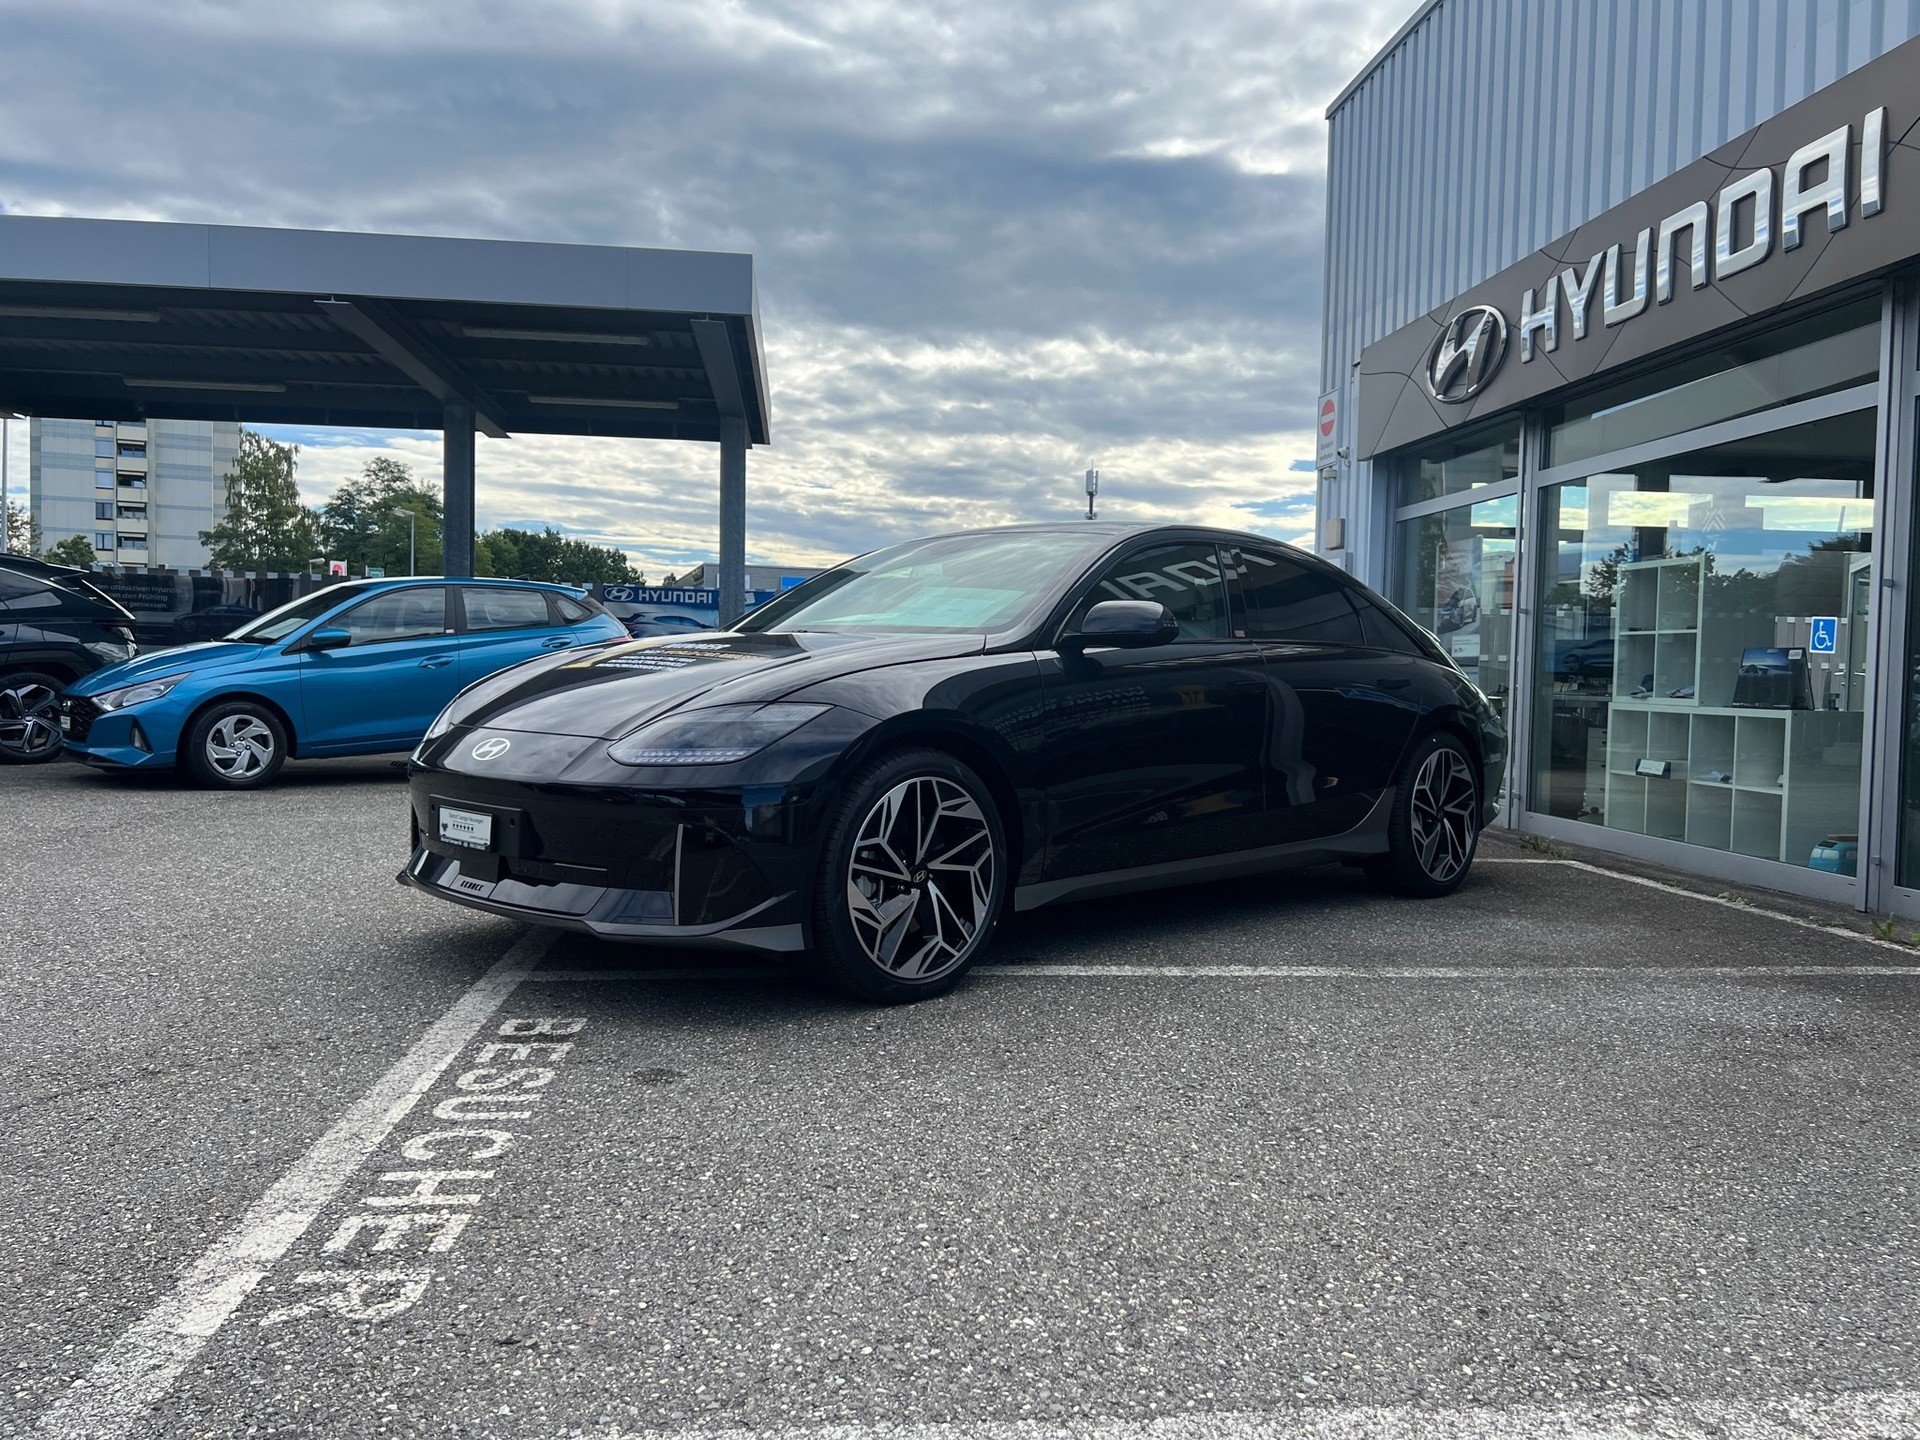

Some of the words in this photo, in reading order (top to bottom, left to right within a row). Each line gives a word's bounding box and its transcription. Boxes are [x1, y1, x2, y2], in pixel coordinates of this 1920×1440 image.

[1520, 105, 1887, 364] HYUNDAI
[110, 584, 150, 592] attraktiven
[138, 593, 168, 602] Frühling
[638, 589, 712, 604] HYUNDAI
[258, 1016, 589, 1327] BESUCHER
